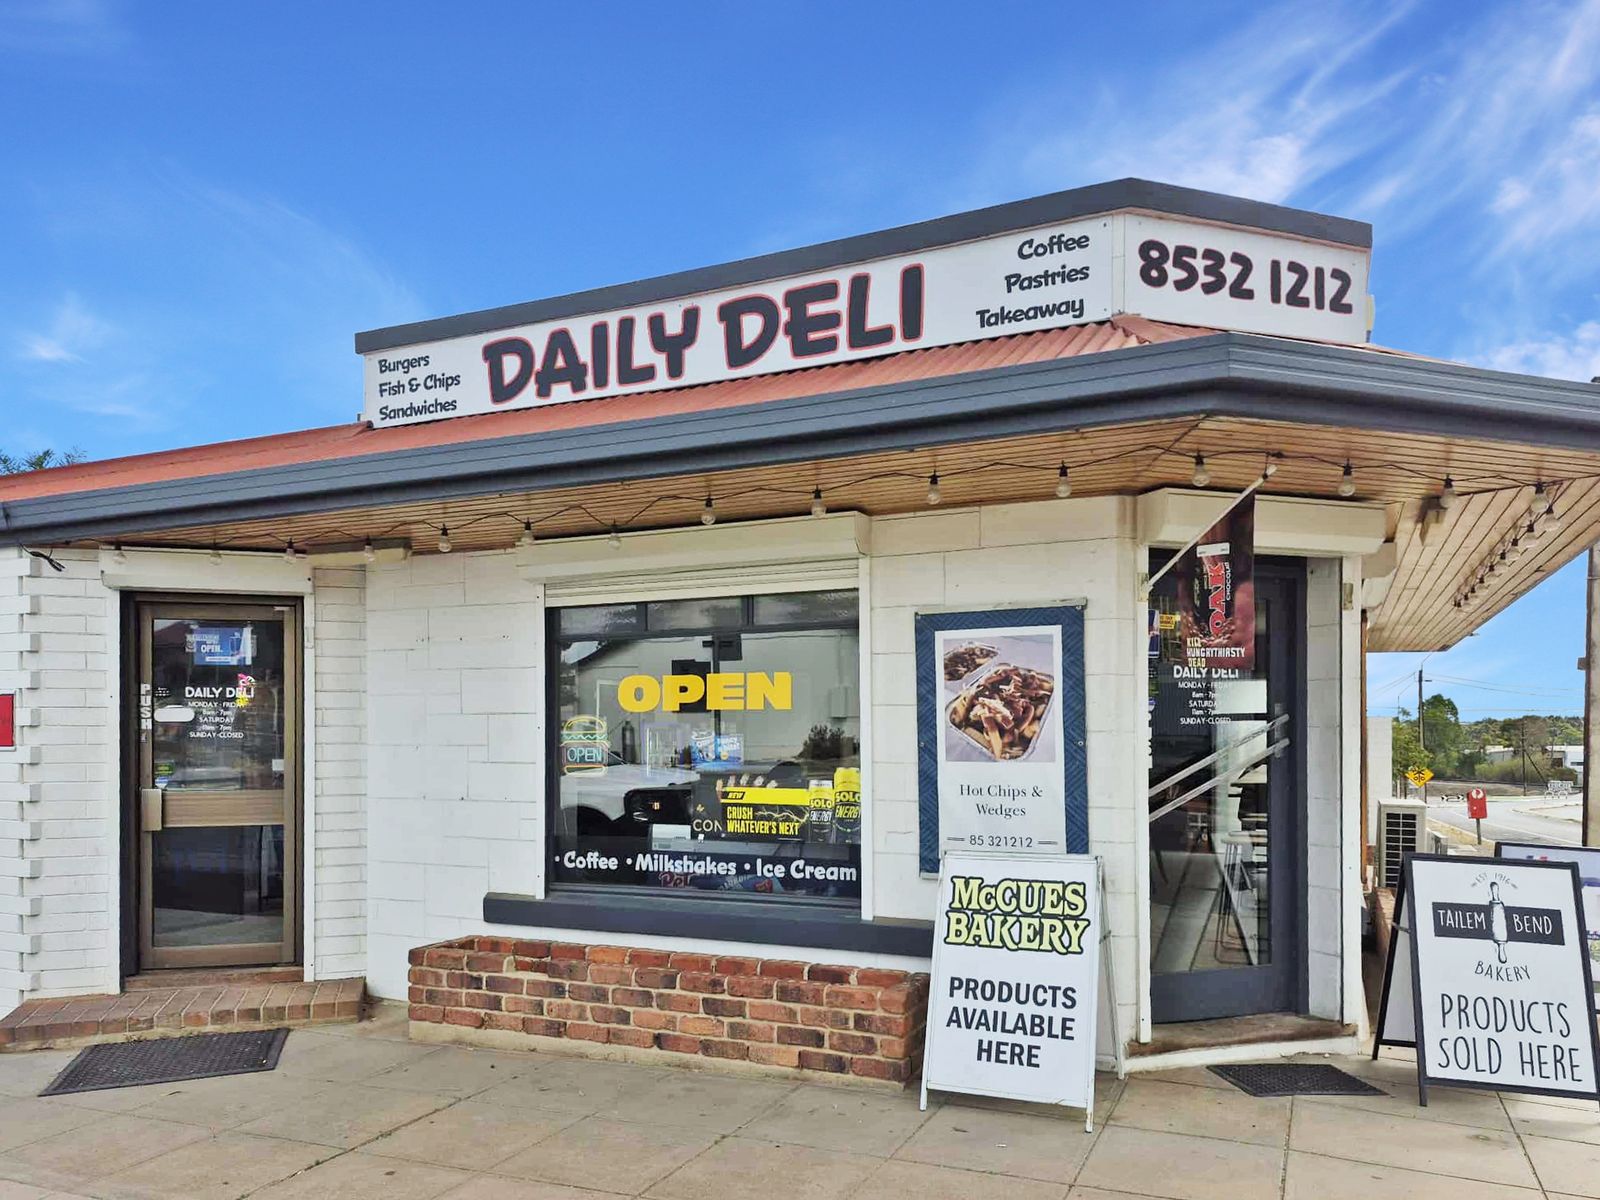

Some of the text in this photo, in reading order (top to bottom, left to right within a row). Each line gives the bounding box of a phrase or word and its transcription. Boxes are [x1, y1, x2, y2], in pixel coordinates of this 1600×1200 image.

[1018, 233, 1089, 260] Coffee
[1005, 263, 1089, 293] Pastries
[1138, 239, 1353, 315] 8532 1212
[976, 298, 1084, 328] Takeaway
[482, 263, 925, 404] DAILY DELI
[378, 355, 430, 374] Burgers
[379, 373, 461, 397] Fish & Chips
[379, 398, 457, 420] Sandwiches
[1209, 562, 1225, 636] OAK
[1173, 665, 1208, 678] DAILY
[1188, 658, 1206, 667] DEAD
[185, 687, 255, 698] DAILY DELI
[617, 671, 793, 712] OPEN
[140, 683, 153, 730] PUSH
[567, 747, 602, 762] OPEN
[727, 791, 744, 799] NEW
[810, 798, 832, 808] SOLO
[835, 791, 861, 803] SOLO
[959, 784, 1043, 801] Hot Chips &
[726, 806, 753, 820] CRUSH
[975, 803, 1026, 819] Wedges
[726, 820, 800, 835] WHATEVER'S NEXT
[969, 835, 1033, 848] 85 321212
[563, 851, 618, 870] Coffee
[635, 854, 737, 875] Milkshakes
[756, 858, 857, 881] Ice Cream
[951, 876, 1090, 917] McCUES
[944, 911, 1090, 955] BAKERY
[1437, 909, 1553, 935] TAILEM BEND
[1474, 960, 1531, 982] BAKERY
[949, 976, 1077, 1009] PRODUCTS
[946, 1006, 1075, 1041] AVAILABLE
[1440, 993, 1571, 1038] PRODUCTS
[977, 1039, 1041, 1068] HERE
[1438, 1036, 1583, 1082] SOLD HERE
